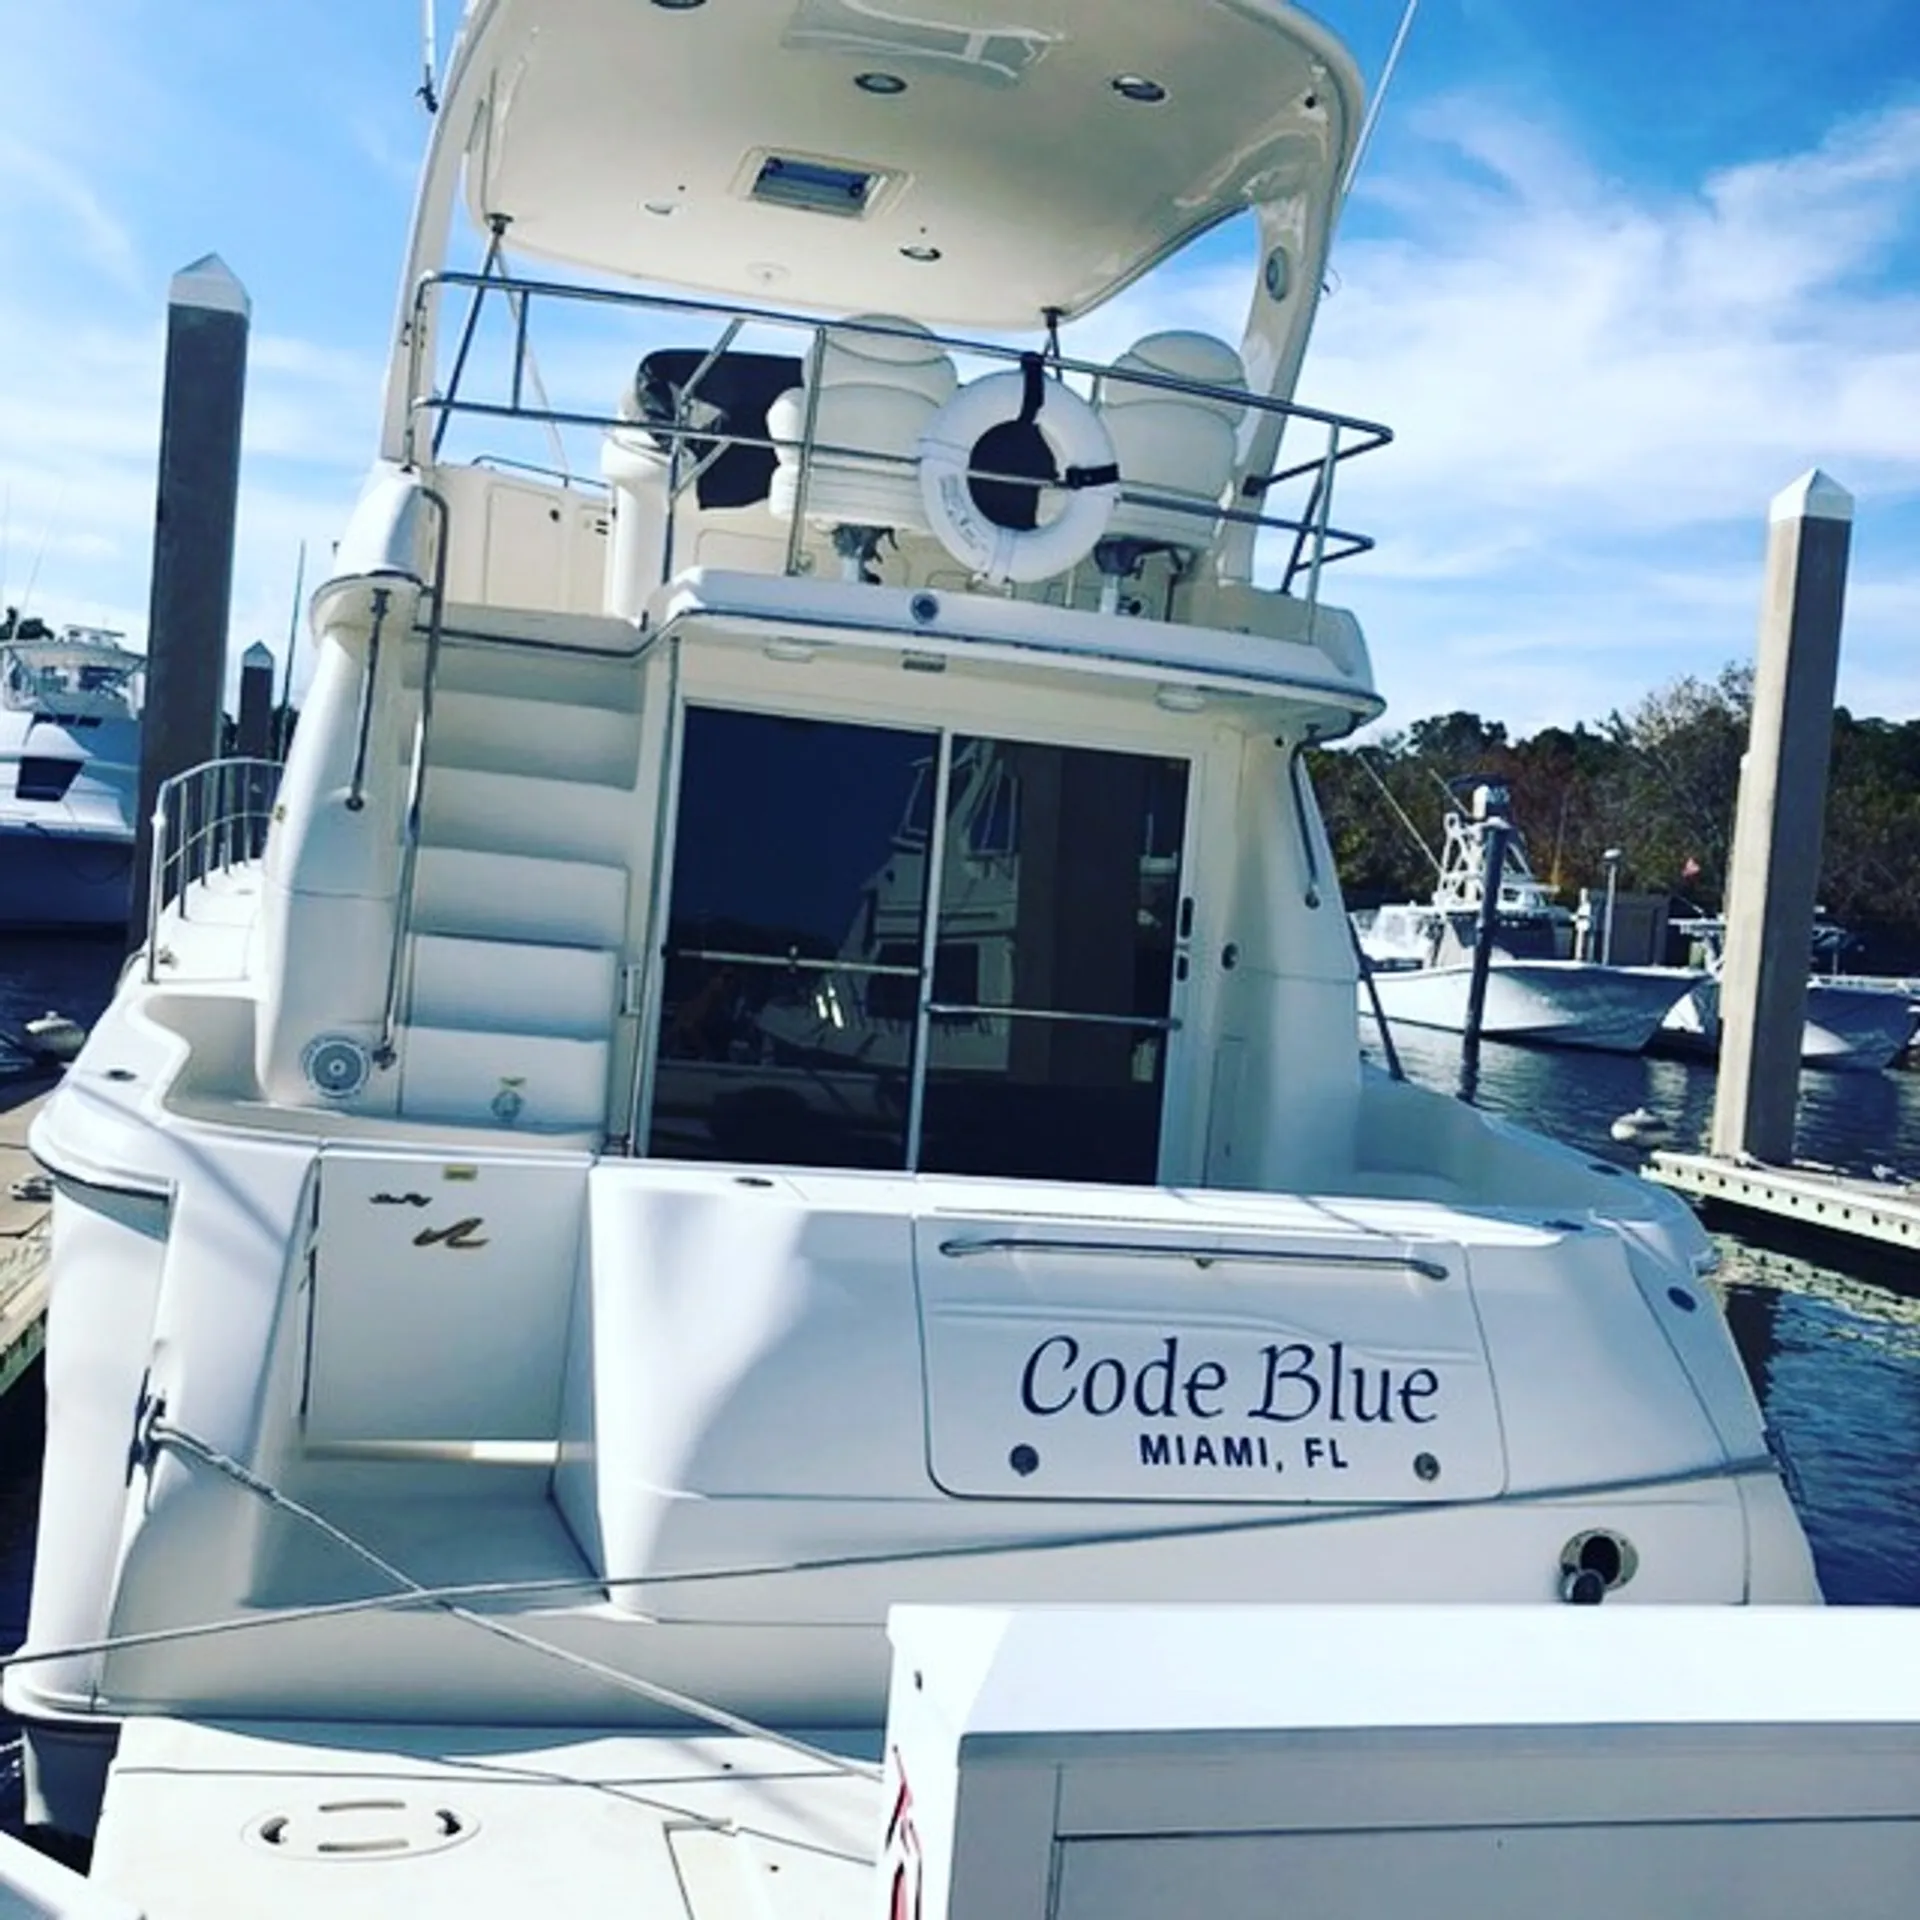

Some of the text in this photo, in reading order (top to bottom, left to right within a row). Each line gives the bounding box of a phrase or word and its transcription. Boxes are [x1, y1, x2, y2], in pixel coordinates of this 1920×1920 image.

[1020, 1335, 1440, 1423] Code Blue
[1139, 1434, 1349, 1473] MIAMI, FL
